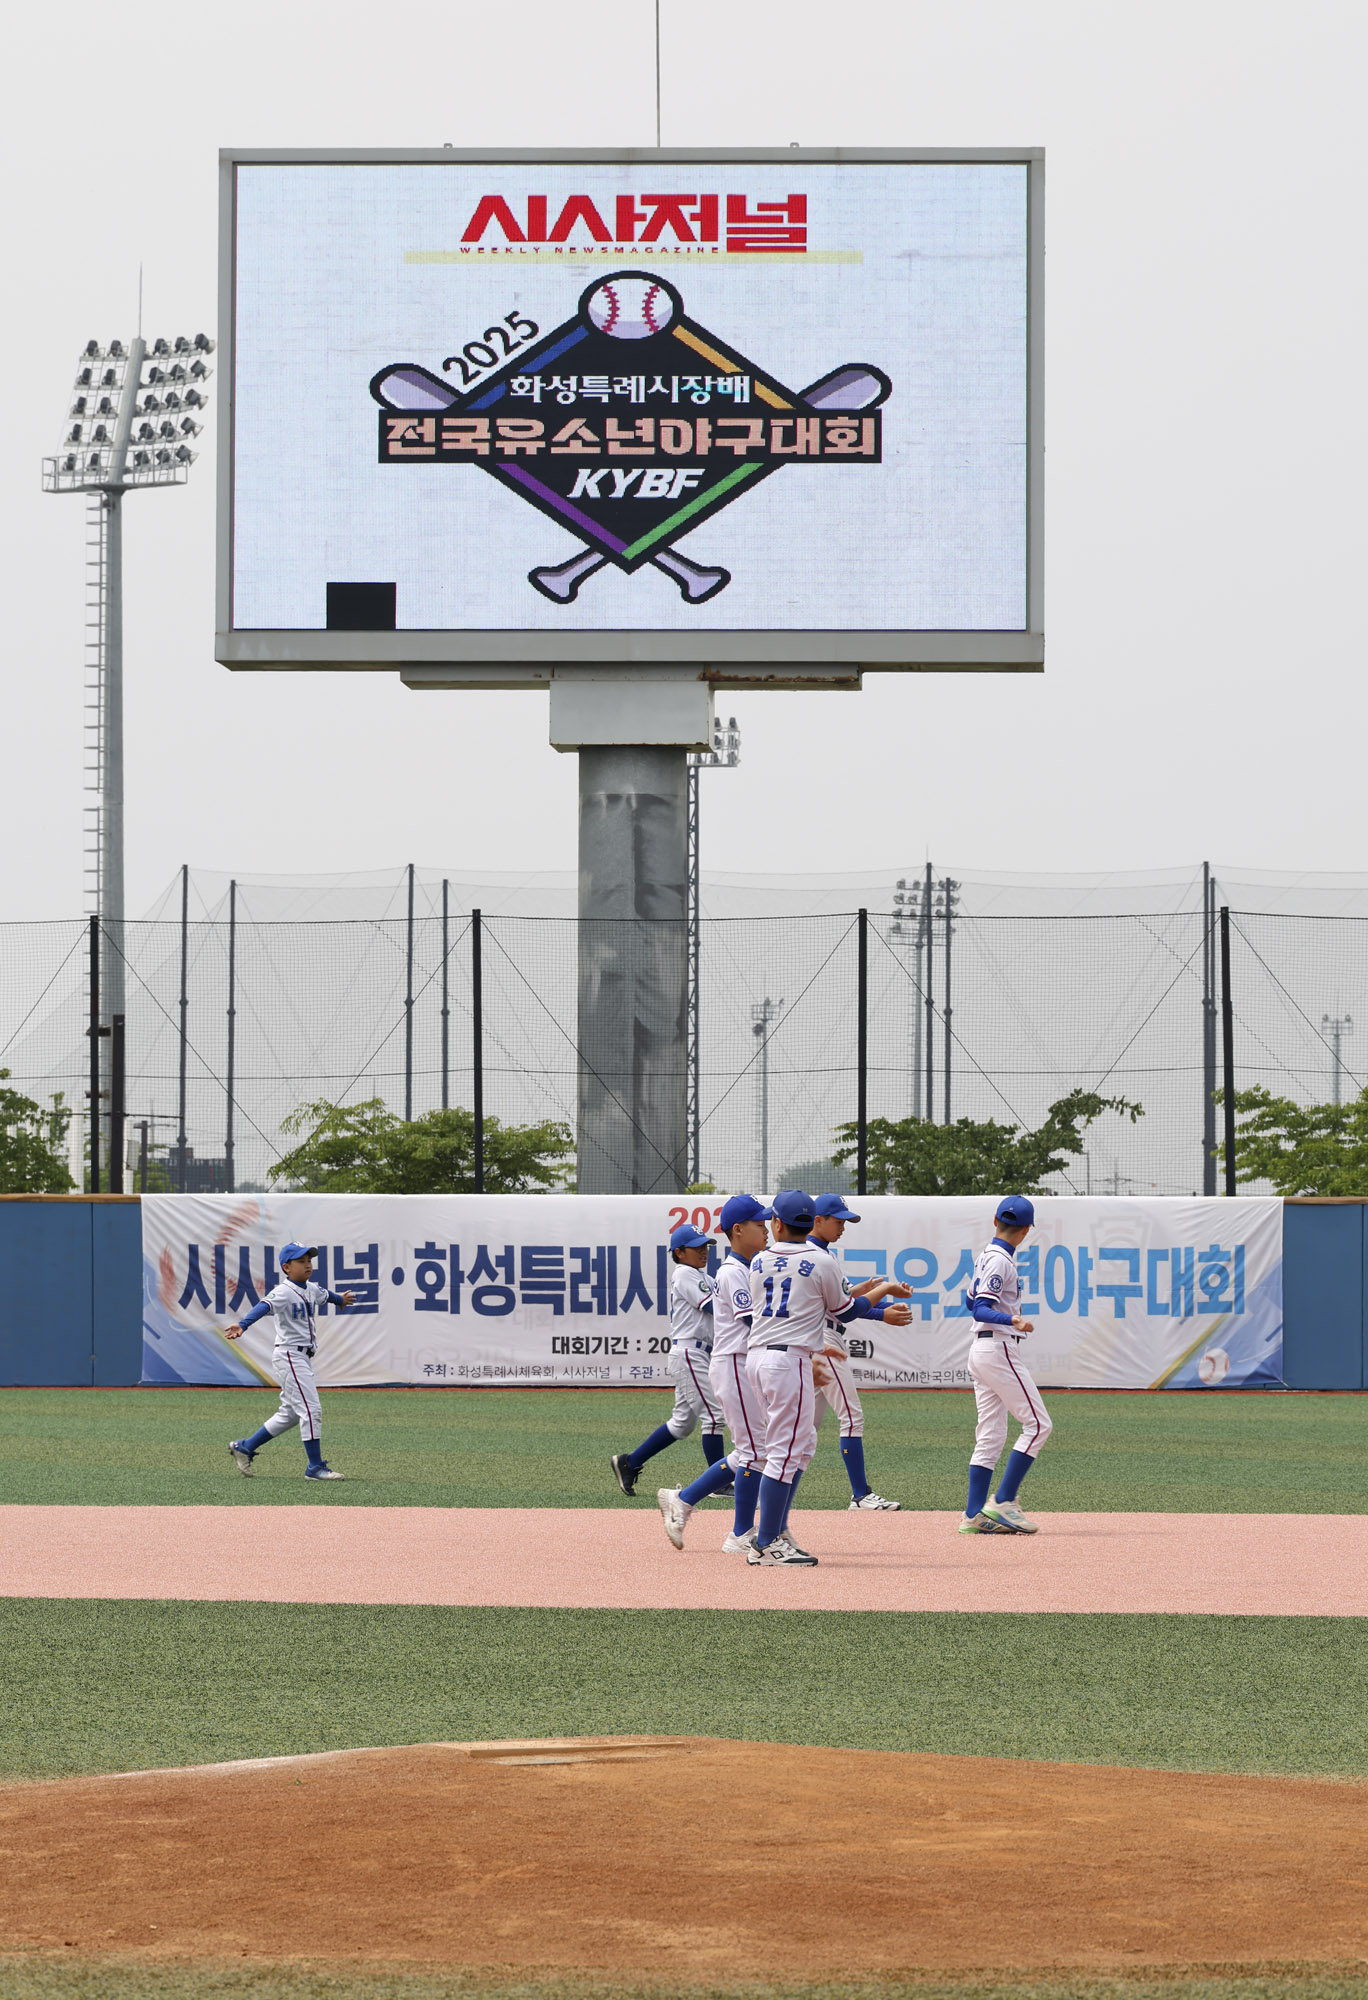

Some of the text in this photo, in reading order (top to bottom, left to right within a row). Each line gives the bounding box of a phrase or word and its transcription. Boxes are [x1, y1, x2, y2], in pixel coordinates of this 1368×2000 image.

[461, 194, 807, 253] 시사저널
[442, 311, 539, 385] 2025
[510, 374, 750, 405] 화성특례시장배
[386, 416, 875, 456] 전국유소년야구대회
[567, 468, 706, 499] KYBF
[761, 1276, 793, 1318] 11
[552, 1336, 629, 1355] 대회기간
[423, 1364, 447, 1377] 주최
[562, 1366, 610, 1379] 시사저널
[629, 1366, 654, 1379] 주관
[852, 1368, 891, 1384] 특례시,
